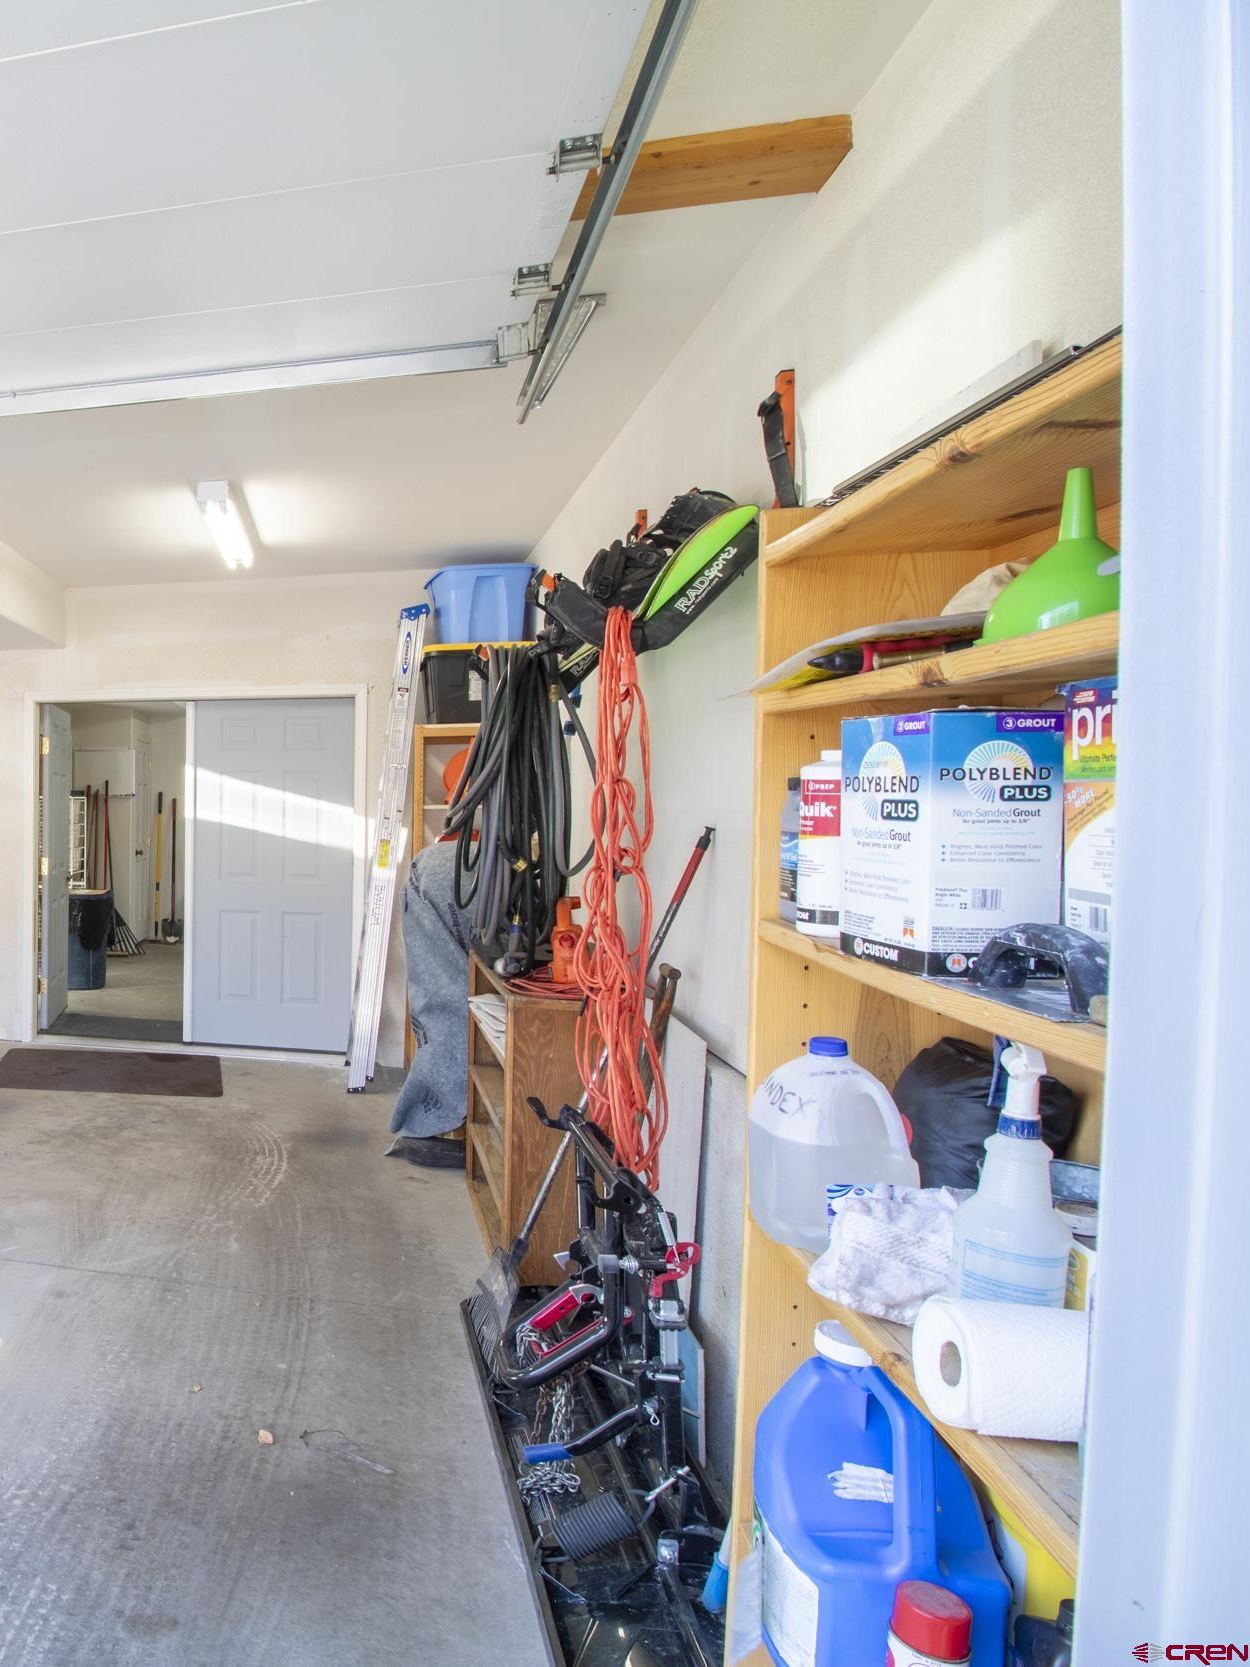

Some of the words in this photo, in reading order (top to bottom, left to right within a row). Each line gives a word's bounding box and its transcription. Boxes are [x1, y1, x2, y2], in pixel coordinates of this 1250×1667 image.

[904, 721, 926, 730] GROUT
[1017, 718, 1056, 728] GROUT
[940, 767, 1053, 781] POLYBLEND
[845, 776, 920, 793] POLYBLEND
[1004, 787, 1048, 799] PLUS
[883, 802, 917, 818] PLUS
[1013, 808, 1041, 817] Grout
[890, 829, 911, 842] Grout
[863, 943, 899, 961] CUSTOM
